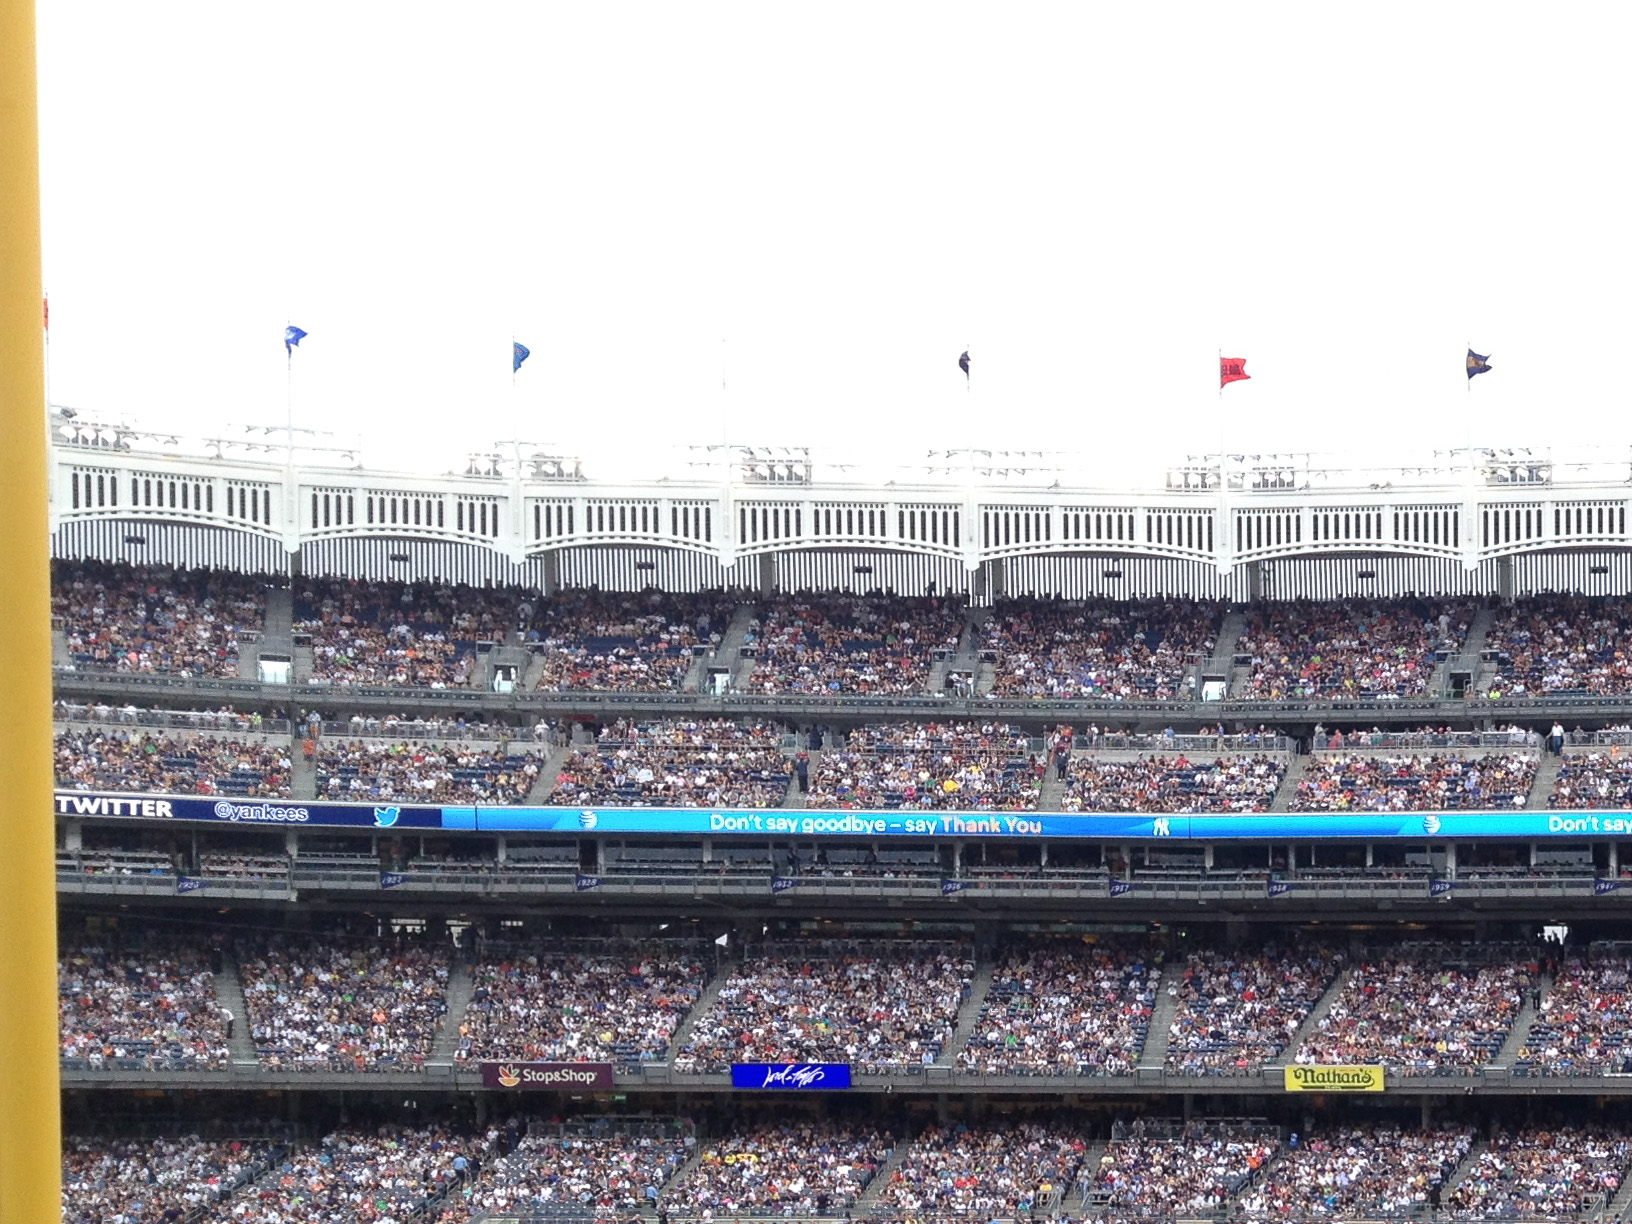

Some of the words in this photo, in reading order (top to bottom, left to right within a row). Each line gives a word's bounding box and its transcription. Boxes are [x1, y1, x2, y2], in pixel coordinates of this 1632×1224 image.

[55, 795, 173, 818] TWITTER
[214, 801, 309, 822] @yankees
[710, 814, 763, 831] Don't
[766, 817, 798, 833] say
[801, 815, 886, 834] goodbye
[905, 818, 938, 835] say
[941, 816, 1001, 833] Thank
[1004, 816, 1042, 834] You
[1549, 815, 1600, 832] Don't
[522, 1068, 596, 1085] Stop&Shop
[1293, 1067, 1373, 1084] Nathan's
